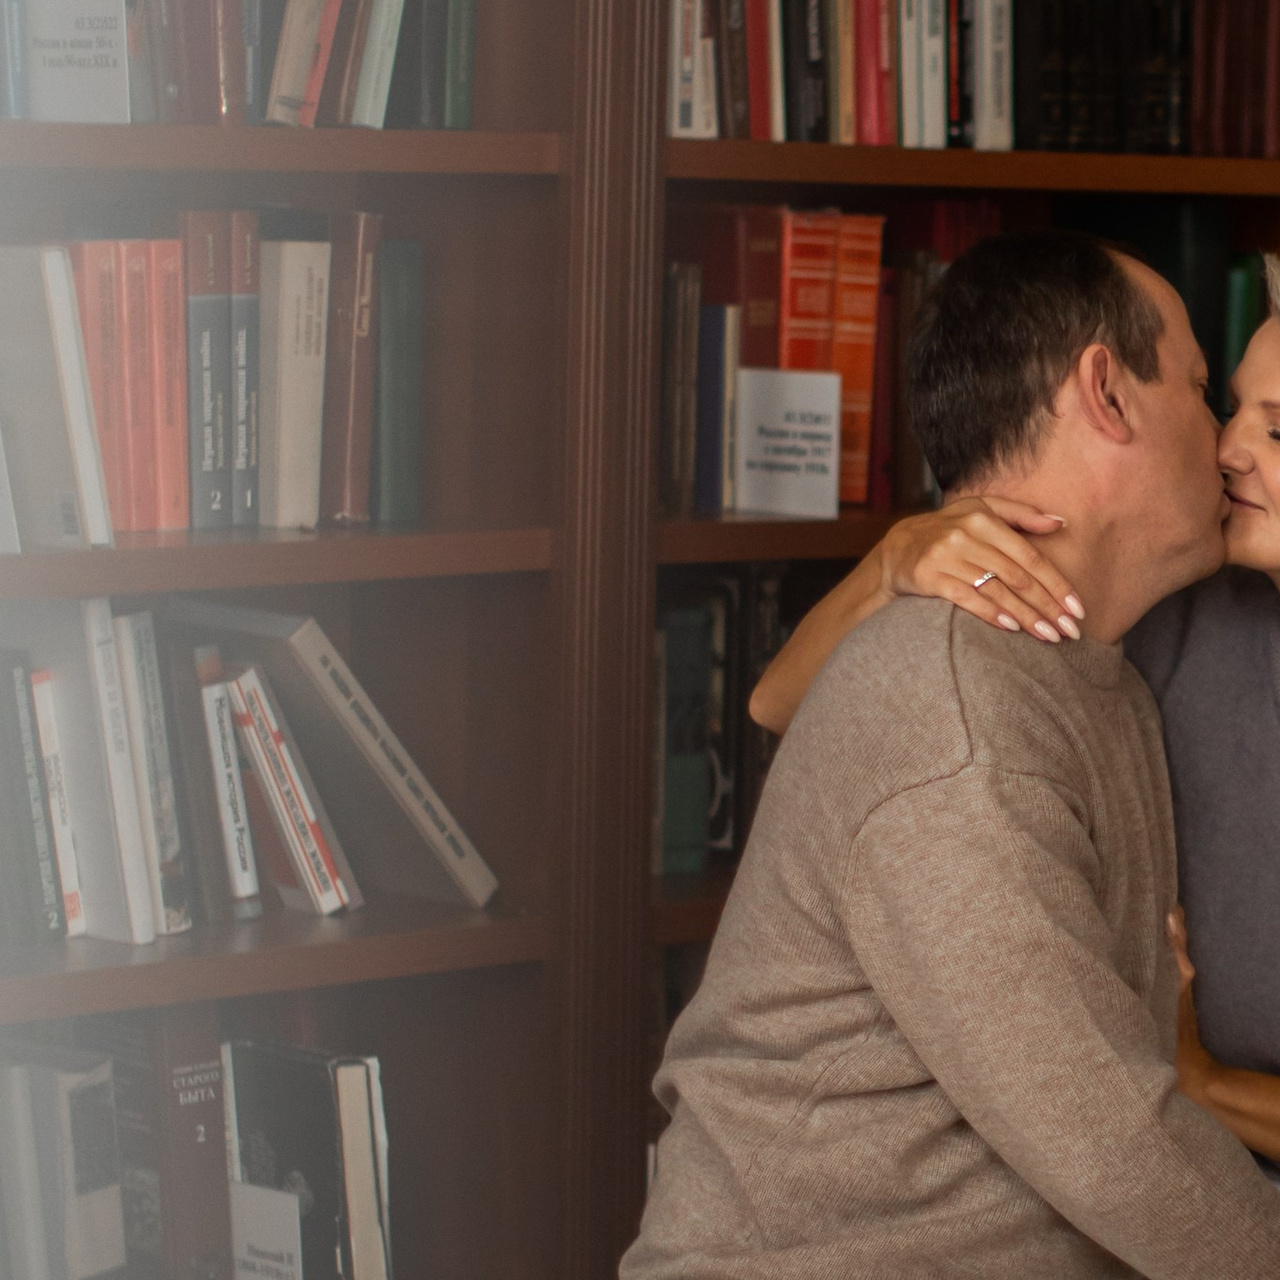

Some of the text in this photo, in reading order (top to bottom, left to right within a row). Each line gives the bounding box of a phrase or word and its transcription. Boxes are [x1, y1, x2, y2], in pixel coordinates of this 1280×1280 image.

[201, 370, 214, 424] мировая
[235, 368, 248, 422] мировая
[202, 425, 215, 472] Первая
[236, 424, 248, 470] Первая
[210, 490, 222, 511] 2
[172, 1071, 220, 1089] СТАРОГО
[179, 1087, 216, 1106] БЫТА
[196, 1124, 206, 1143] 2
